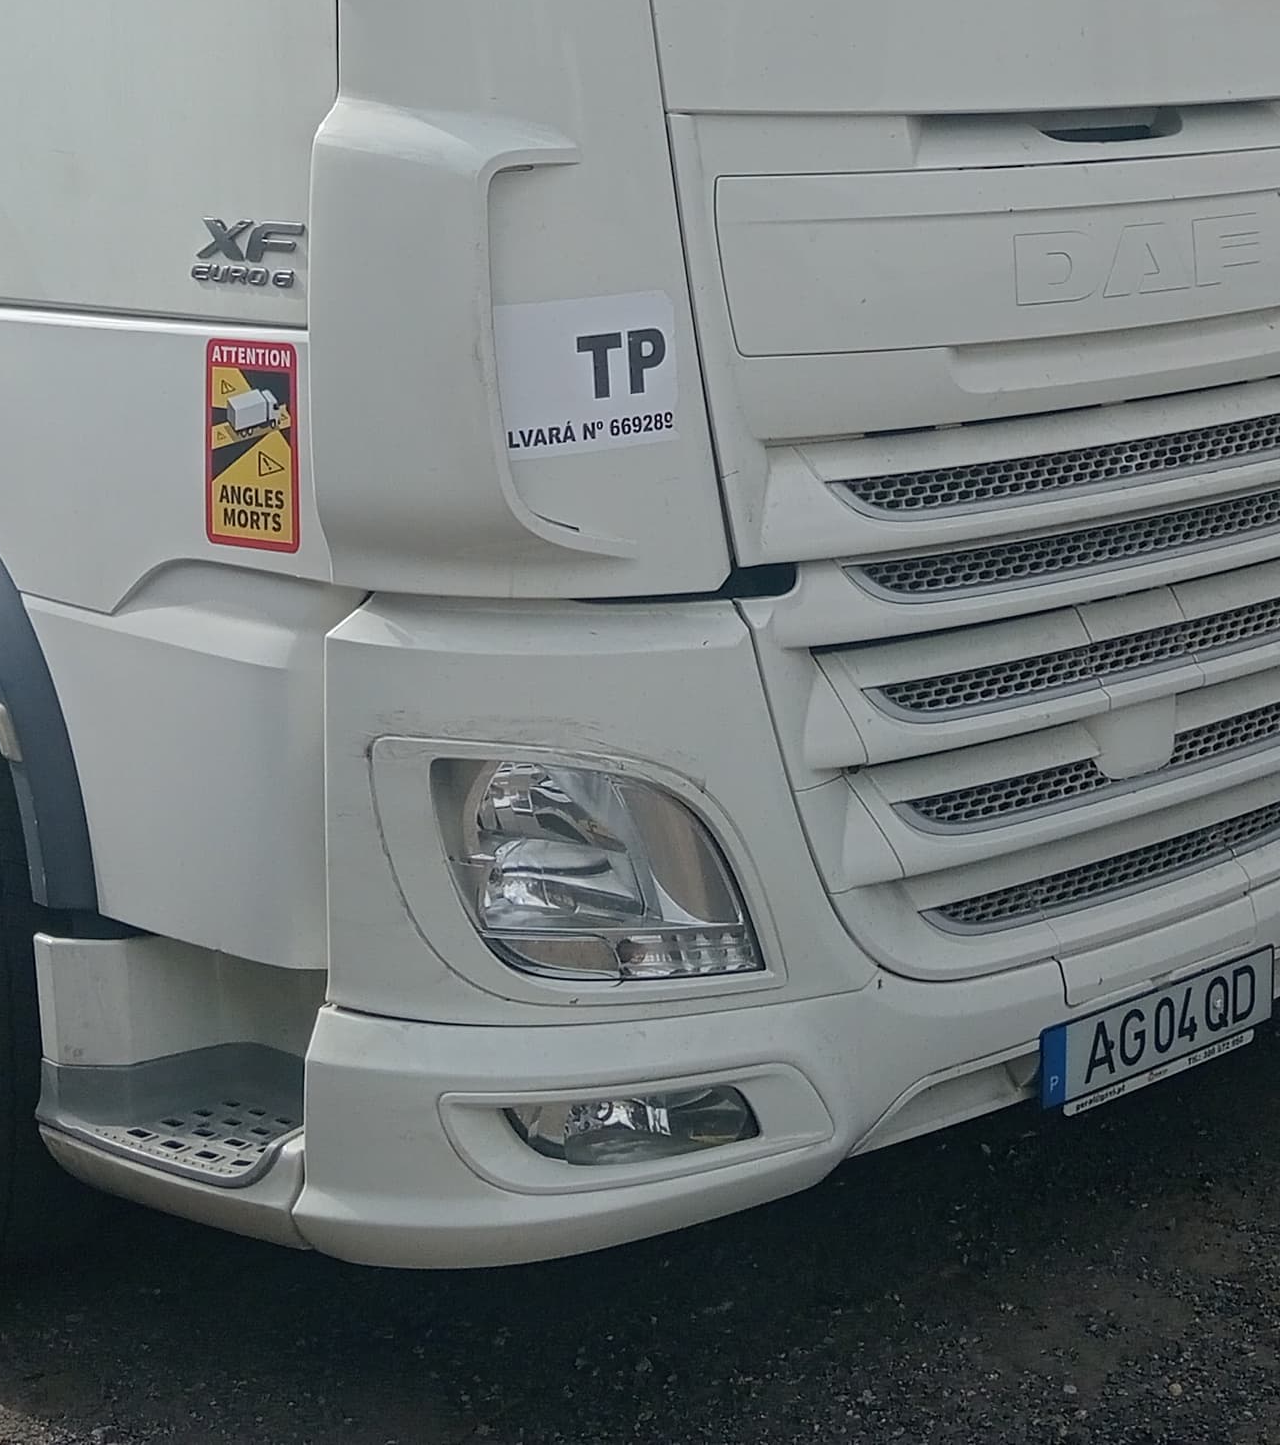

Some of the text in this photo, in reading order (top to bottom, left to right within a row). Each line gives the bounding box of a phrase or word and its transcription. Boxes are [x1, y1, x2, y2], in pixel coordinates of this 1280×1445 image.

[196, 216, 306, 263] XF
[1013, 211, 1261, 306] DAF
[211, 344, 291, 367] ATTENTION
[576, 328, 666, 400] TP
[507, 422, 576, 449] LVARÁ
[610, 411, 673, 437] 669289
[219, 484, 285, 510] ANGLES
[223, 508, 283, 533] MORTS
